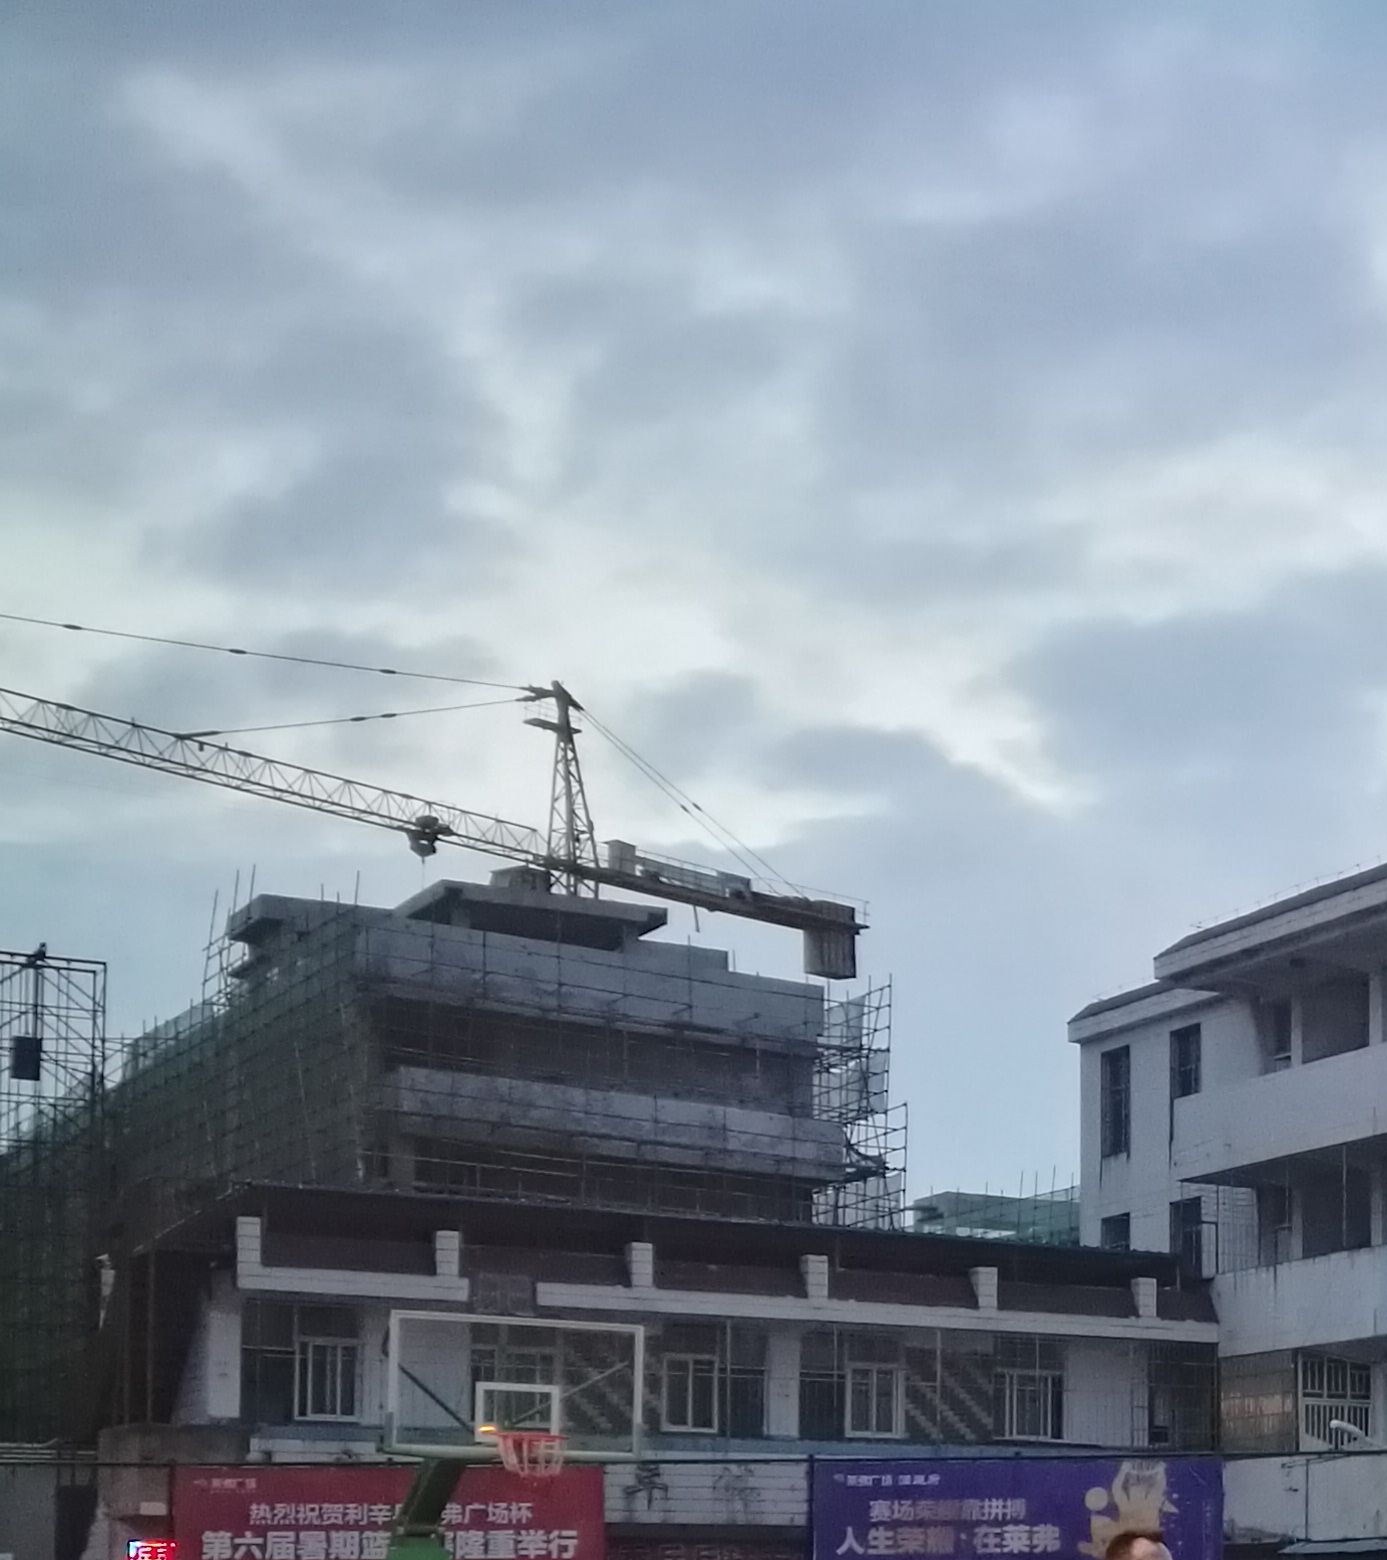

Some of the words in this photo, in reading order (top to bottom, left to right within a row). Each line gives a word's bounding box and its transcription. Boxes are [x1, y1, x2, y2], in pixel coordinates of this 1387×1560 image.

[250, 1501, 533, 1525] 热烈祝贺利辛弗广场杯
[201, 1530, 578, 1560] 第六届暑期篮隆重举行
